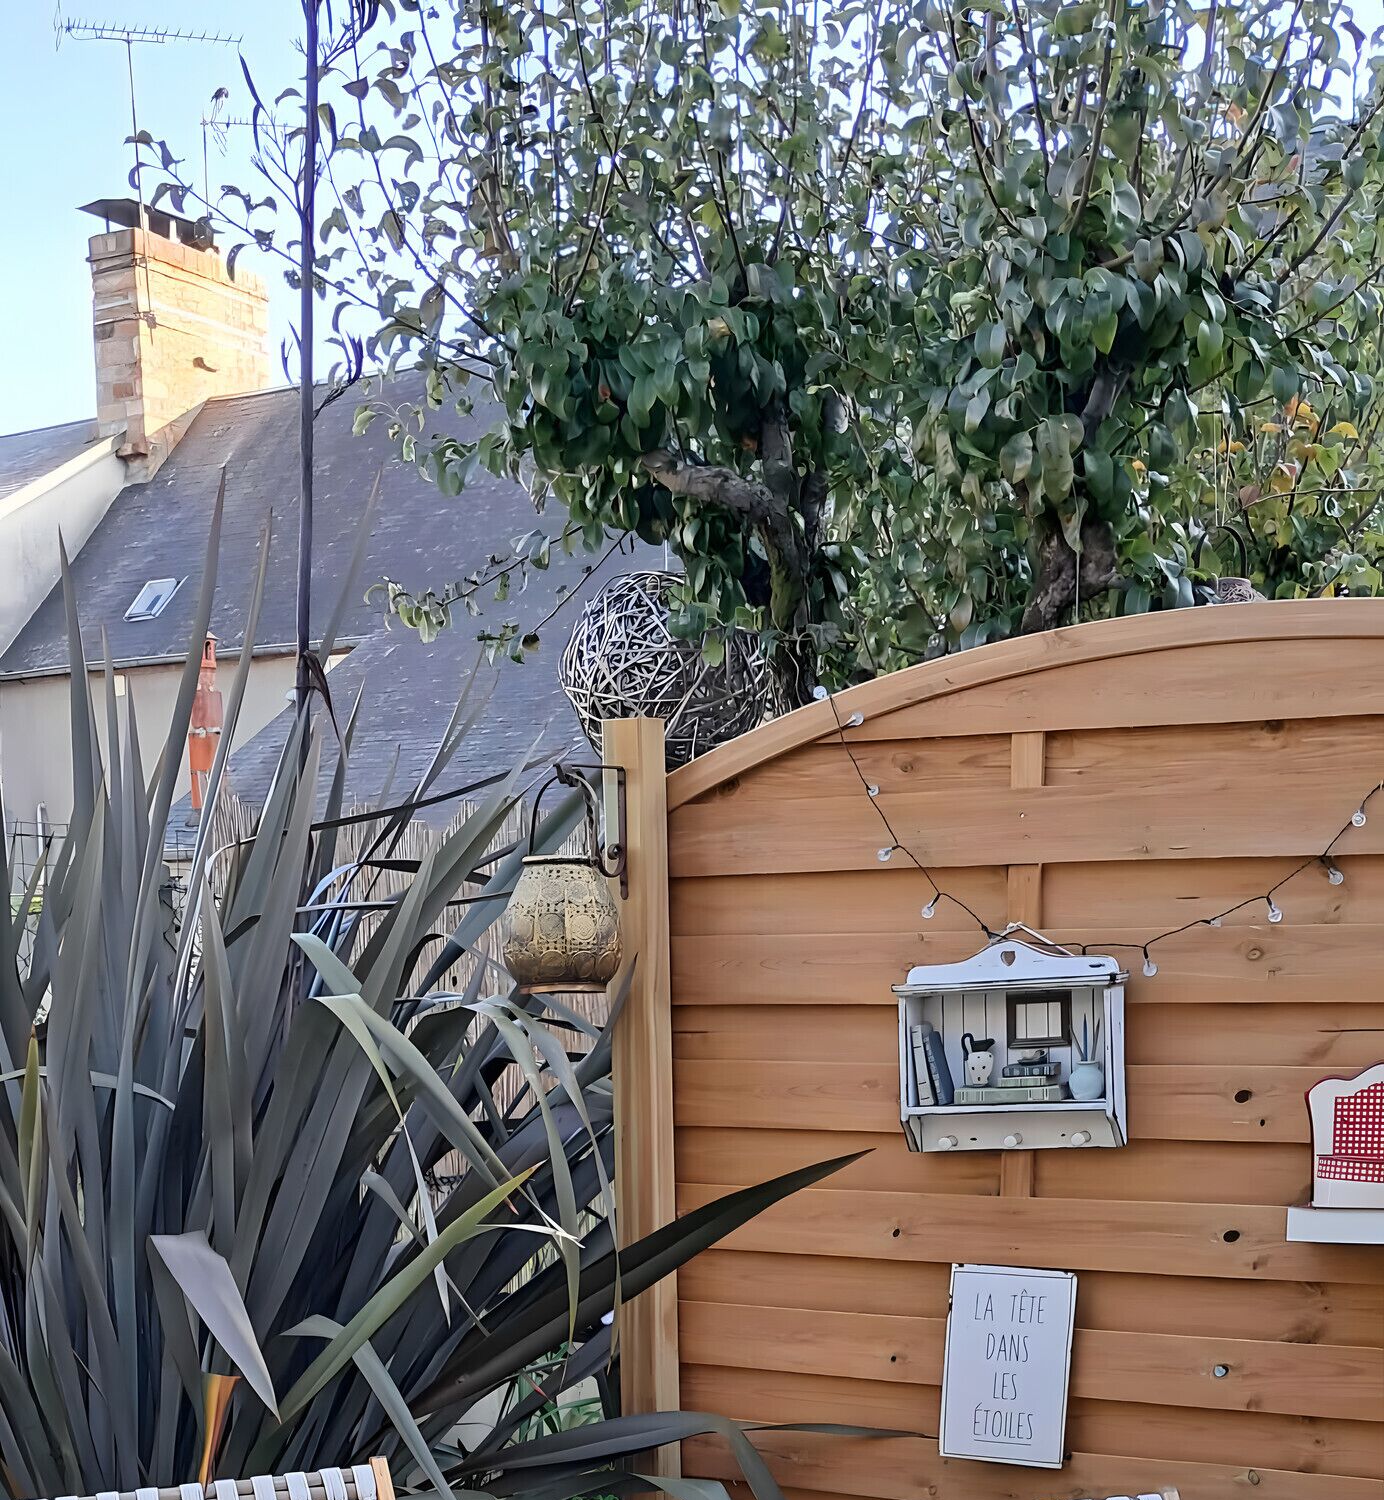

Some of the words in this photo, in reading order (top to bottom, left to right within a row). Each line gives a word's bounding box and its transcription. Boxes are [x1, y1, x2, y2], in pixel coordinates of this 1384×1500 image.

[974, 1292, 994, 1322] LA
[1010, 1288, 1048, 1324] TÊTE
[986, 1332, 1030, 1363] DANS
[992, 1372, 1018, 1400] LES
[973, 1402, 1034, 1440] ÉTOILES
